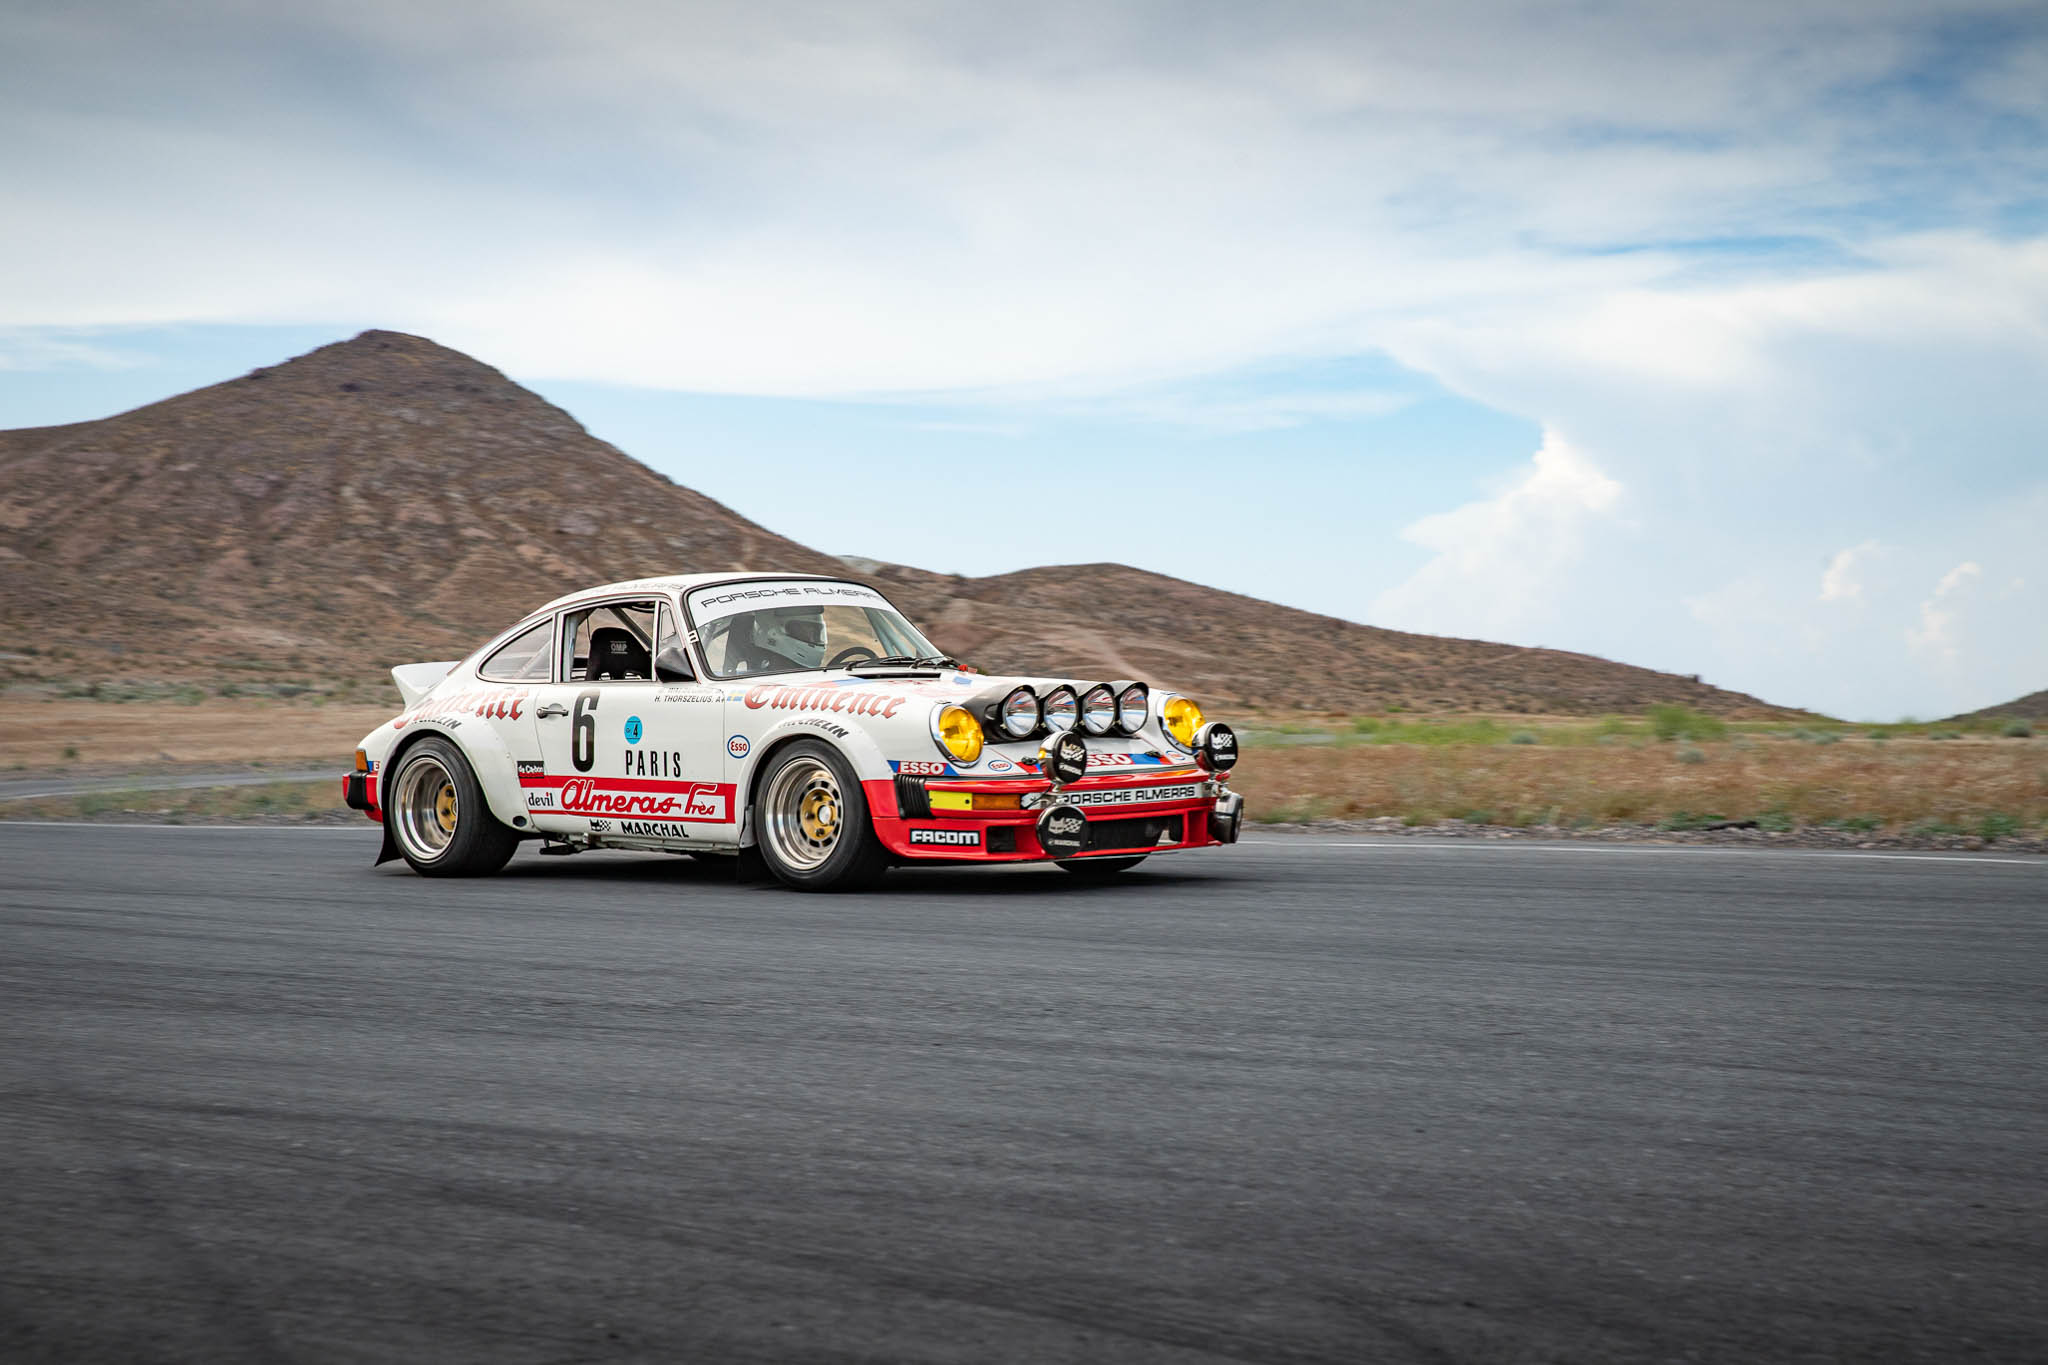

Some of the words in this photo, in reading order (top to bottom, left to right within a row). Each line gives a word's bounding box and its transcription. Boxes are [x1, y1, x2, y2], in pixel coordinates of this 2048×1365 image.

[701, 588, 801, 608] PORSCHE
[610, 643, 628, 651] OMP
[572, 688, 600, 772] 6
[625, 750, 681, 777] PARIS
[1086, 753, 1132, 767] SSO
[900, 763, 944, 775] ESSO
[528, 792, 554, 807] devil
[1135, 786, 1195, 800] ALMERAS
[621, 821, 689, 838] MARCHAL
[911, 830, 979, 844] FACOM
